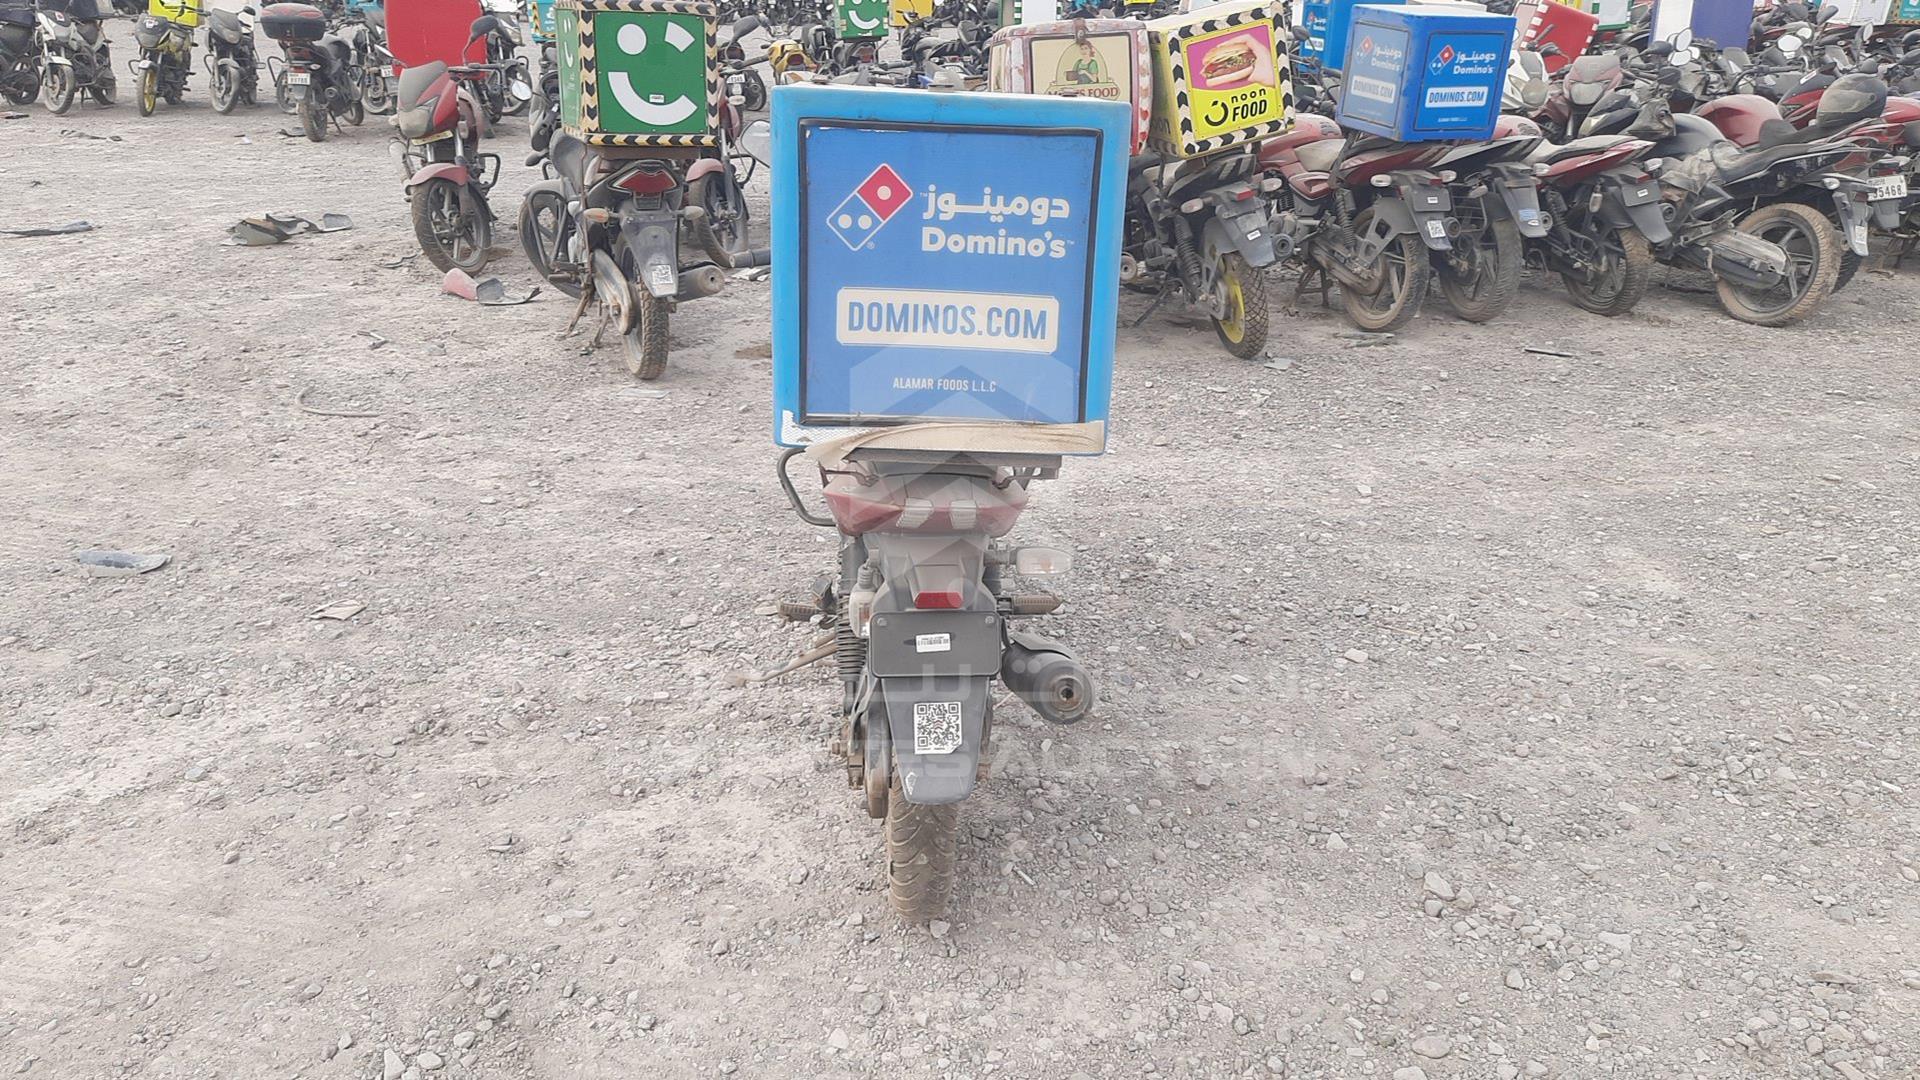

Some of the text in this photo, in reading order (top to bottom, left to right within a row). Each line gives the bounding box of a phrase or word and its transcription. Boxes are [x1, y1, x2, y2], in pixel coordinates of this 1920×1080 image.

[1455, 51, 1496, 63] دومينوز
[1453, 65, 1493, 74] Domino's
[1088, 87, 1118, 98] FOOD
[1231, 88, 1266, 103] noon
[1428, 91, 1485, 104] DOMINOS.COM
[1232, 99, 1267, 121] FOOD
[923, 184, 1069, 225] دومينوز
[921, 226, 1066, 258] Domino's
[848, 301, 1047, 341] DOMINOS.COM
[893, 377, 997, 393] ALAMAR FOODS L.L.C
